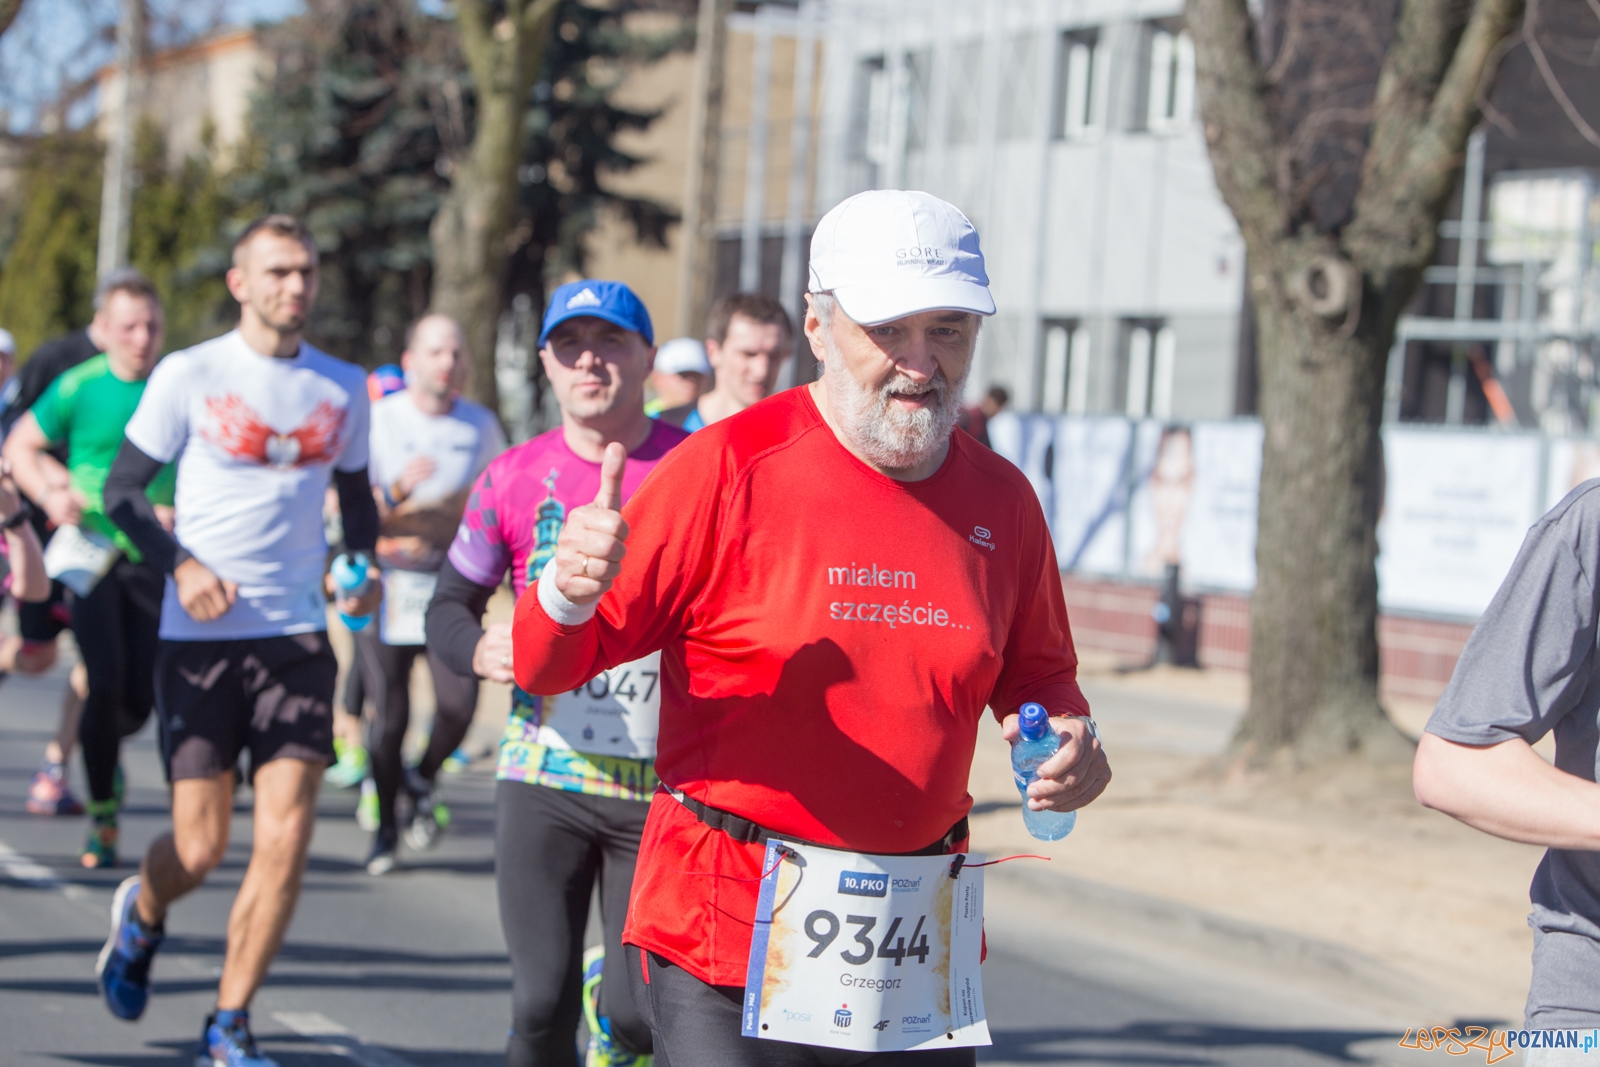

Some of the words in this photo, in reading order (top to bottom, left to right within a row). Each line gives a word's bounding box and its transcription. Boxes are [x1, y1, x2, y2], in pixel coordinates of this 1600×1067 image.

[896, 246, 943, 259] GORE
[969, 534, 996, 551] Kalenji
[828, 562, 916, 590] miałem
[829, 600, 971, 630] szczęście...
[572, 670, 659, 703] 047
[844, 877, 859, 889] 10.
[860, 879, 885, 891] PKO
[803, 909, 929, 967] 9344
[839, 973, 902, 993] Grzegorz
[786, 1010, 813, 1022] posir
